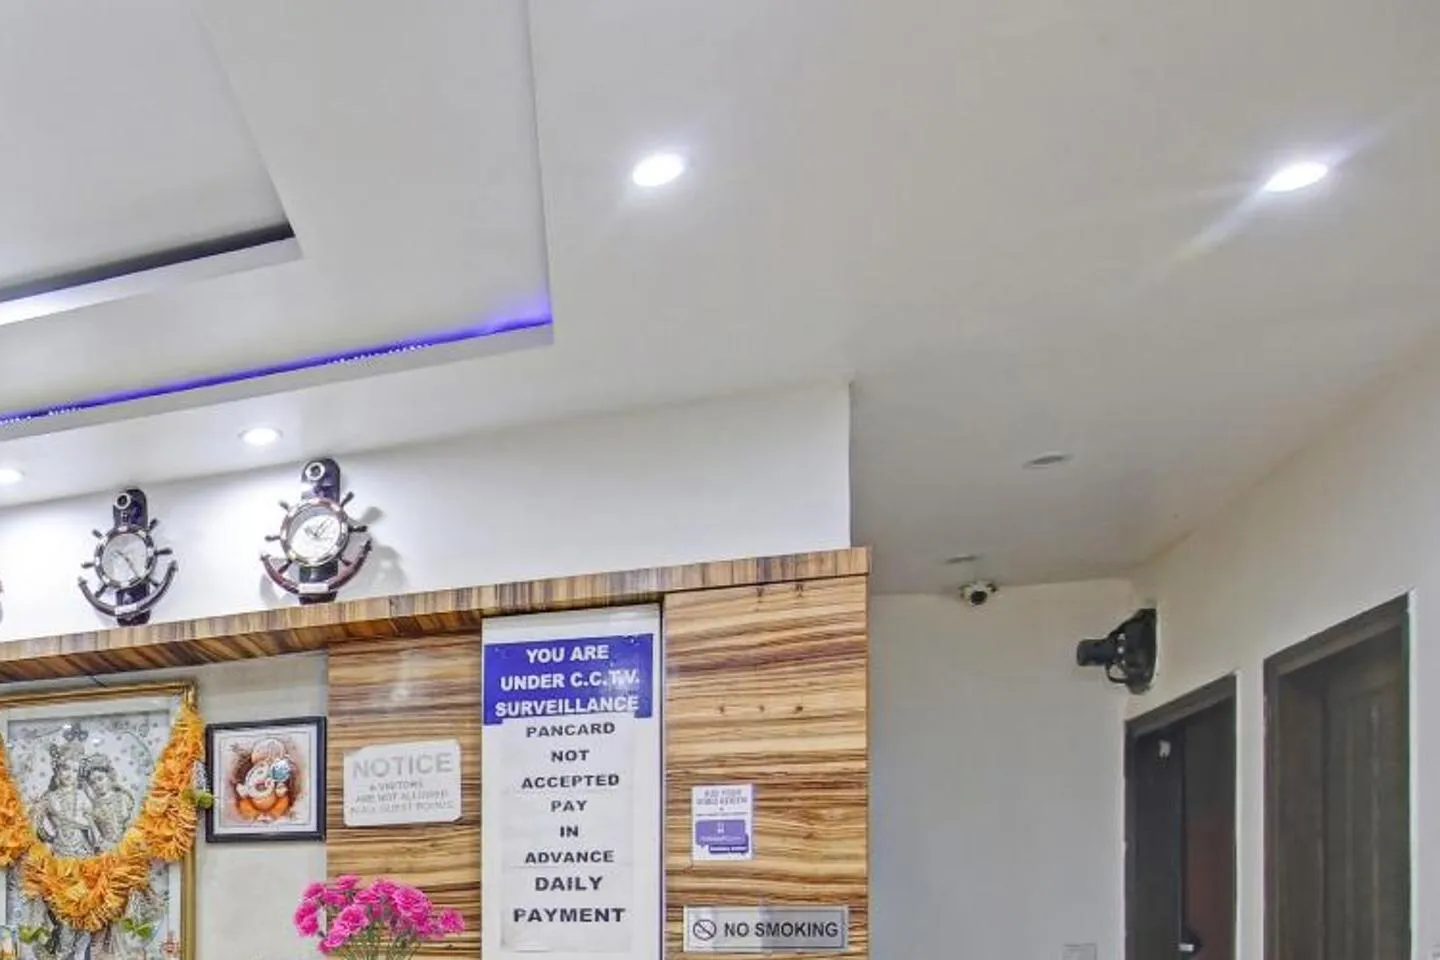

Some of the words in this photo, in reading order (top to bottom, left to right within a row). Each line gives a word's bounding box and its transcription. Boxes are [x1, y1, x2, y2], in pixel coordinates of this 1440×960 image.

[526, 648, 565, 663] YOU
[570, 645, 609, 661] ARE
[500, 674, 565, 691] UNDER
[495, 696, 640, 717] SURVEILLANCE
[526, 722, 616, 738] PANCARD
[551, 749, 590, 763] NOT
[352, 751, 454, 780] NOTICE
[521, 774, 620, 789] ACCEPTED
[550, 800, 588, 812] PAY
[560, 825, 579, 838] IN
[525, 850, 615, 864] ADVANCE
[534, 876, 604, 892] DAILY
[513, 908, 626, 923] PAYMENT
[724, 922, 749, 937] NO
[755, 922, 839, 938] SMOKING
